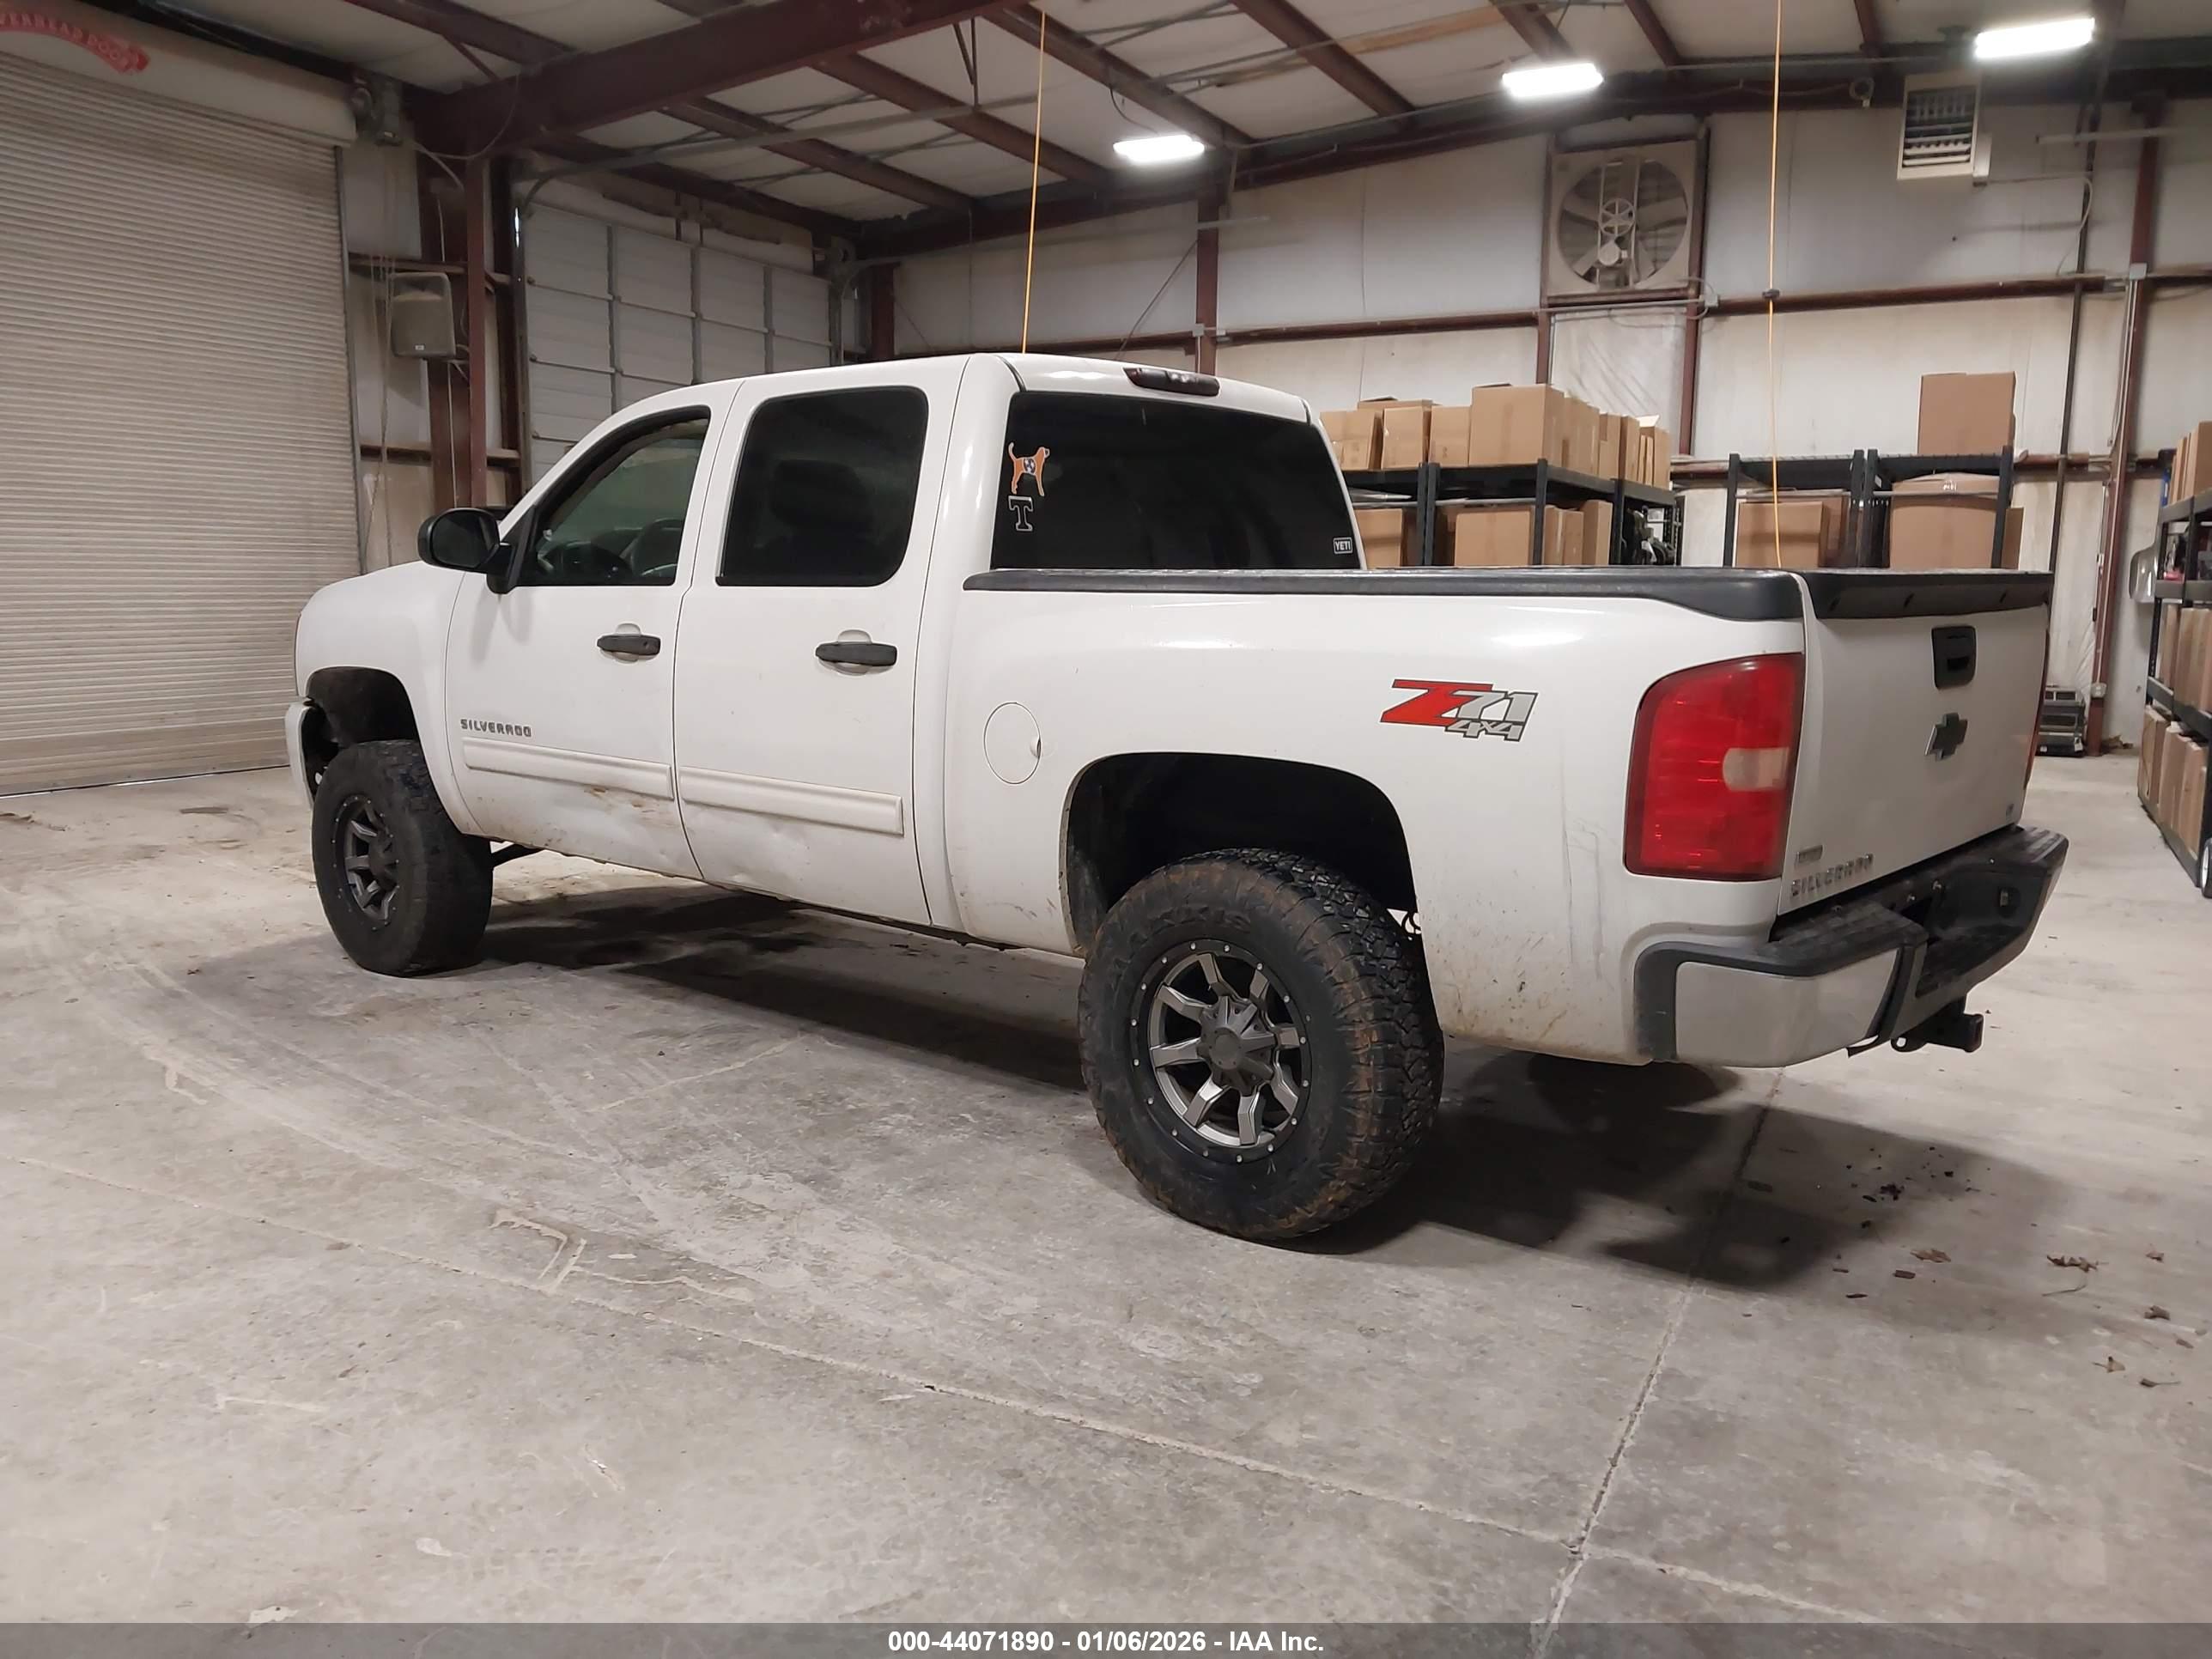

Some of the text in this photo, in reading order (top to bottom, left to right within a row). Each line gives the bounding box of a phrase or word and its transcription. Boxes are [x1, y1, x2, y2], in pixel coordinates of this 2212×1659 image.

[1007, 495, 1034, 532] T
[1334, 540, 1351, 551] YETI
[1380, 678, 1539, 727] Z71
[460, 719, 532, 738] SILVERADO
